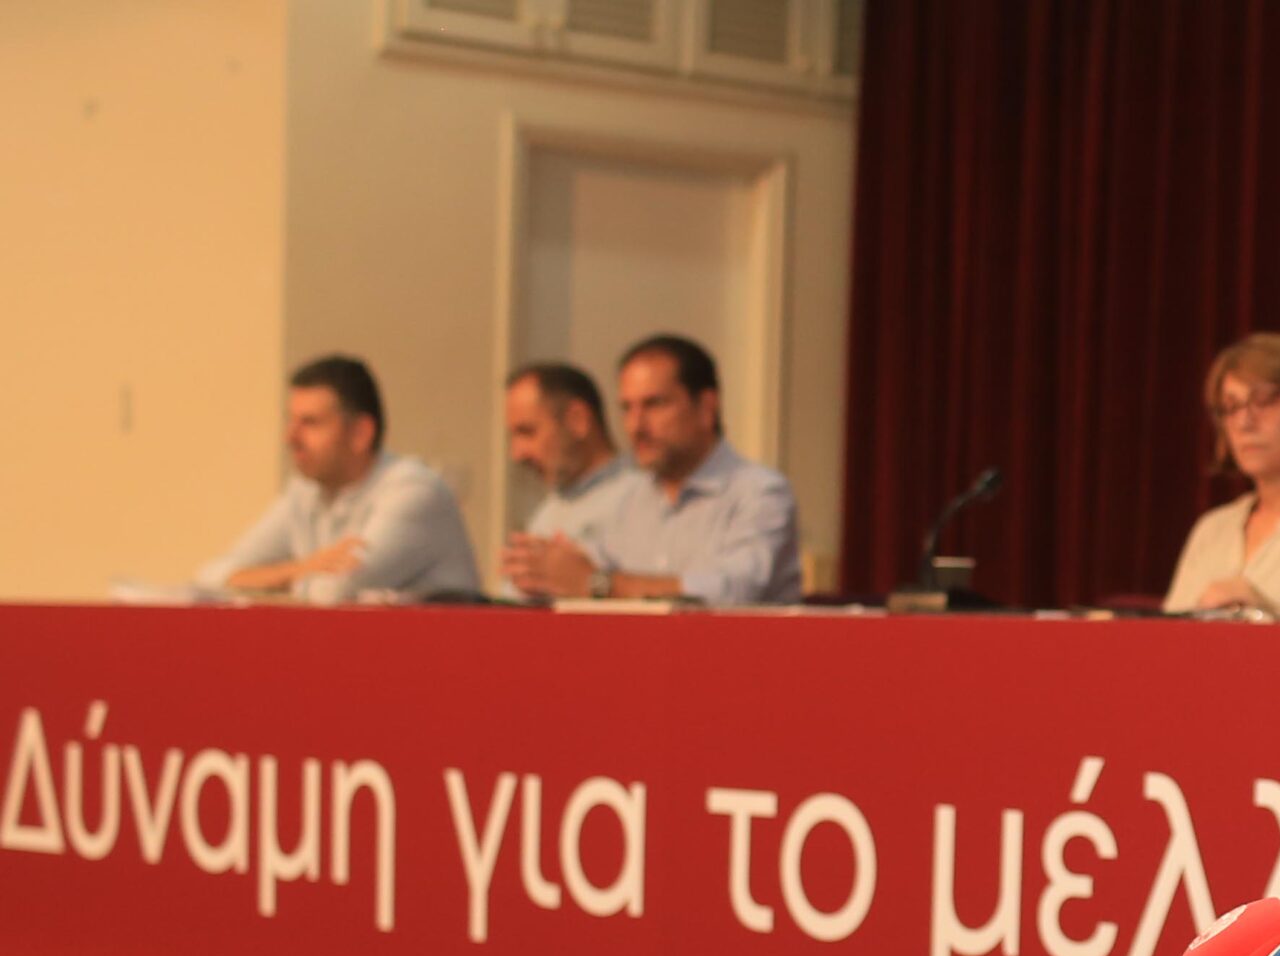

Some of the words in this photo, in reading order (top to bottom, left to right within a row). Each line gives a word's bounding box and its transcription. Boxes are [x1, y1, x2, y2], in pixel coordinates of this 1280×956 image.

[0, 701, 397, 932] Δύναμη
[444, 767, 648, 944] για
[705, 786, 878, 943] το
